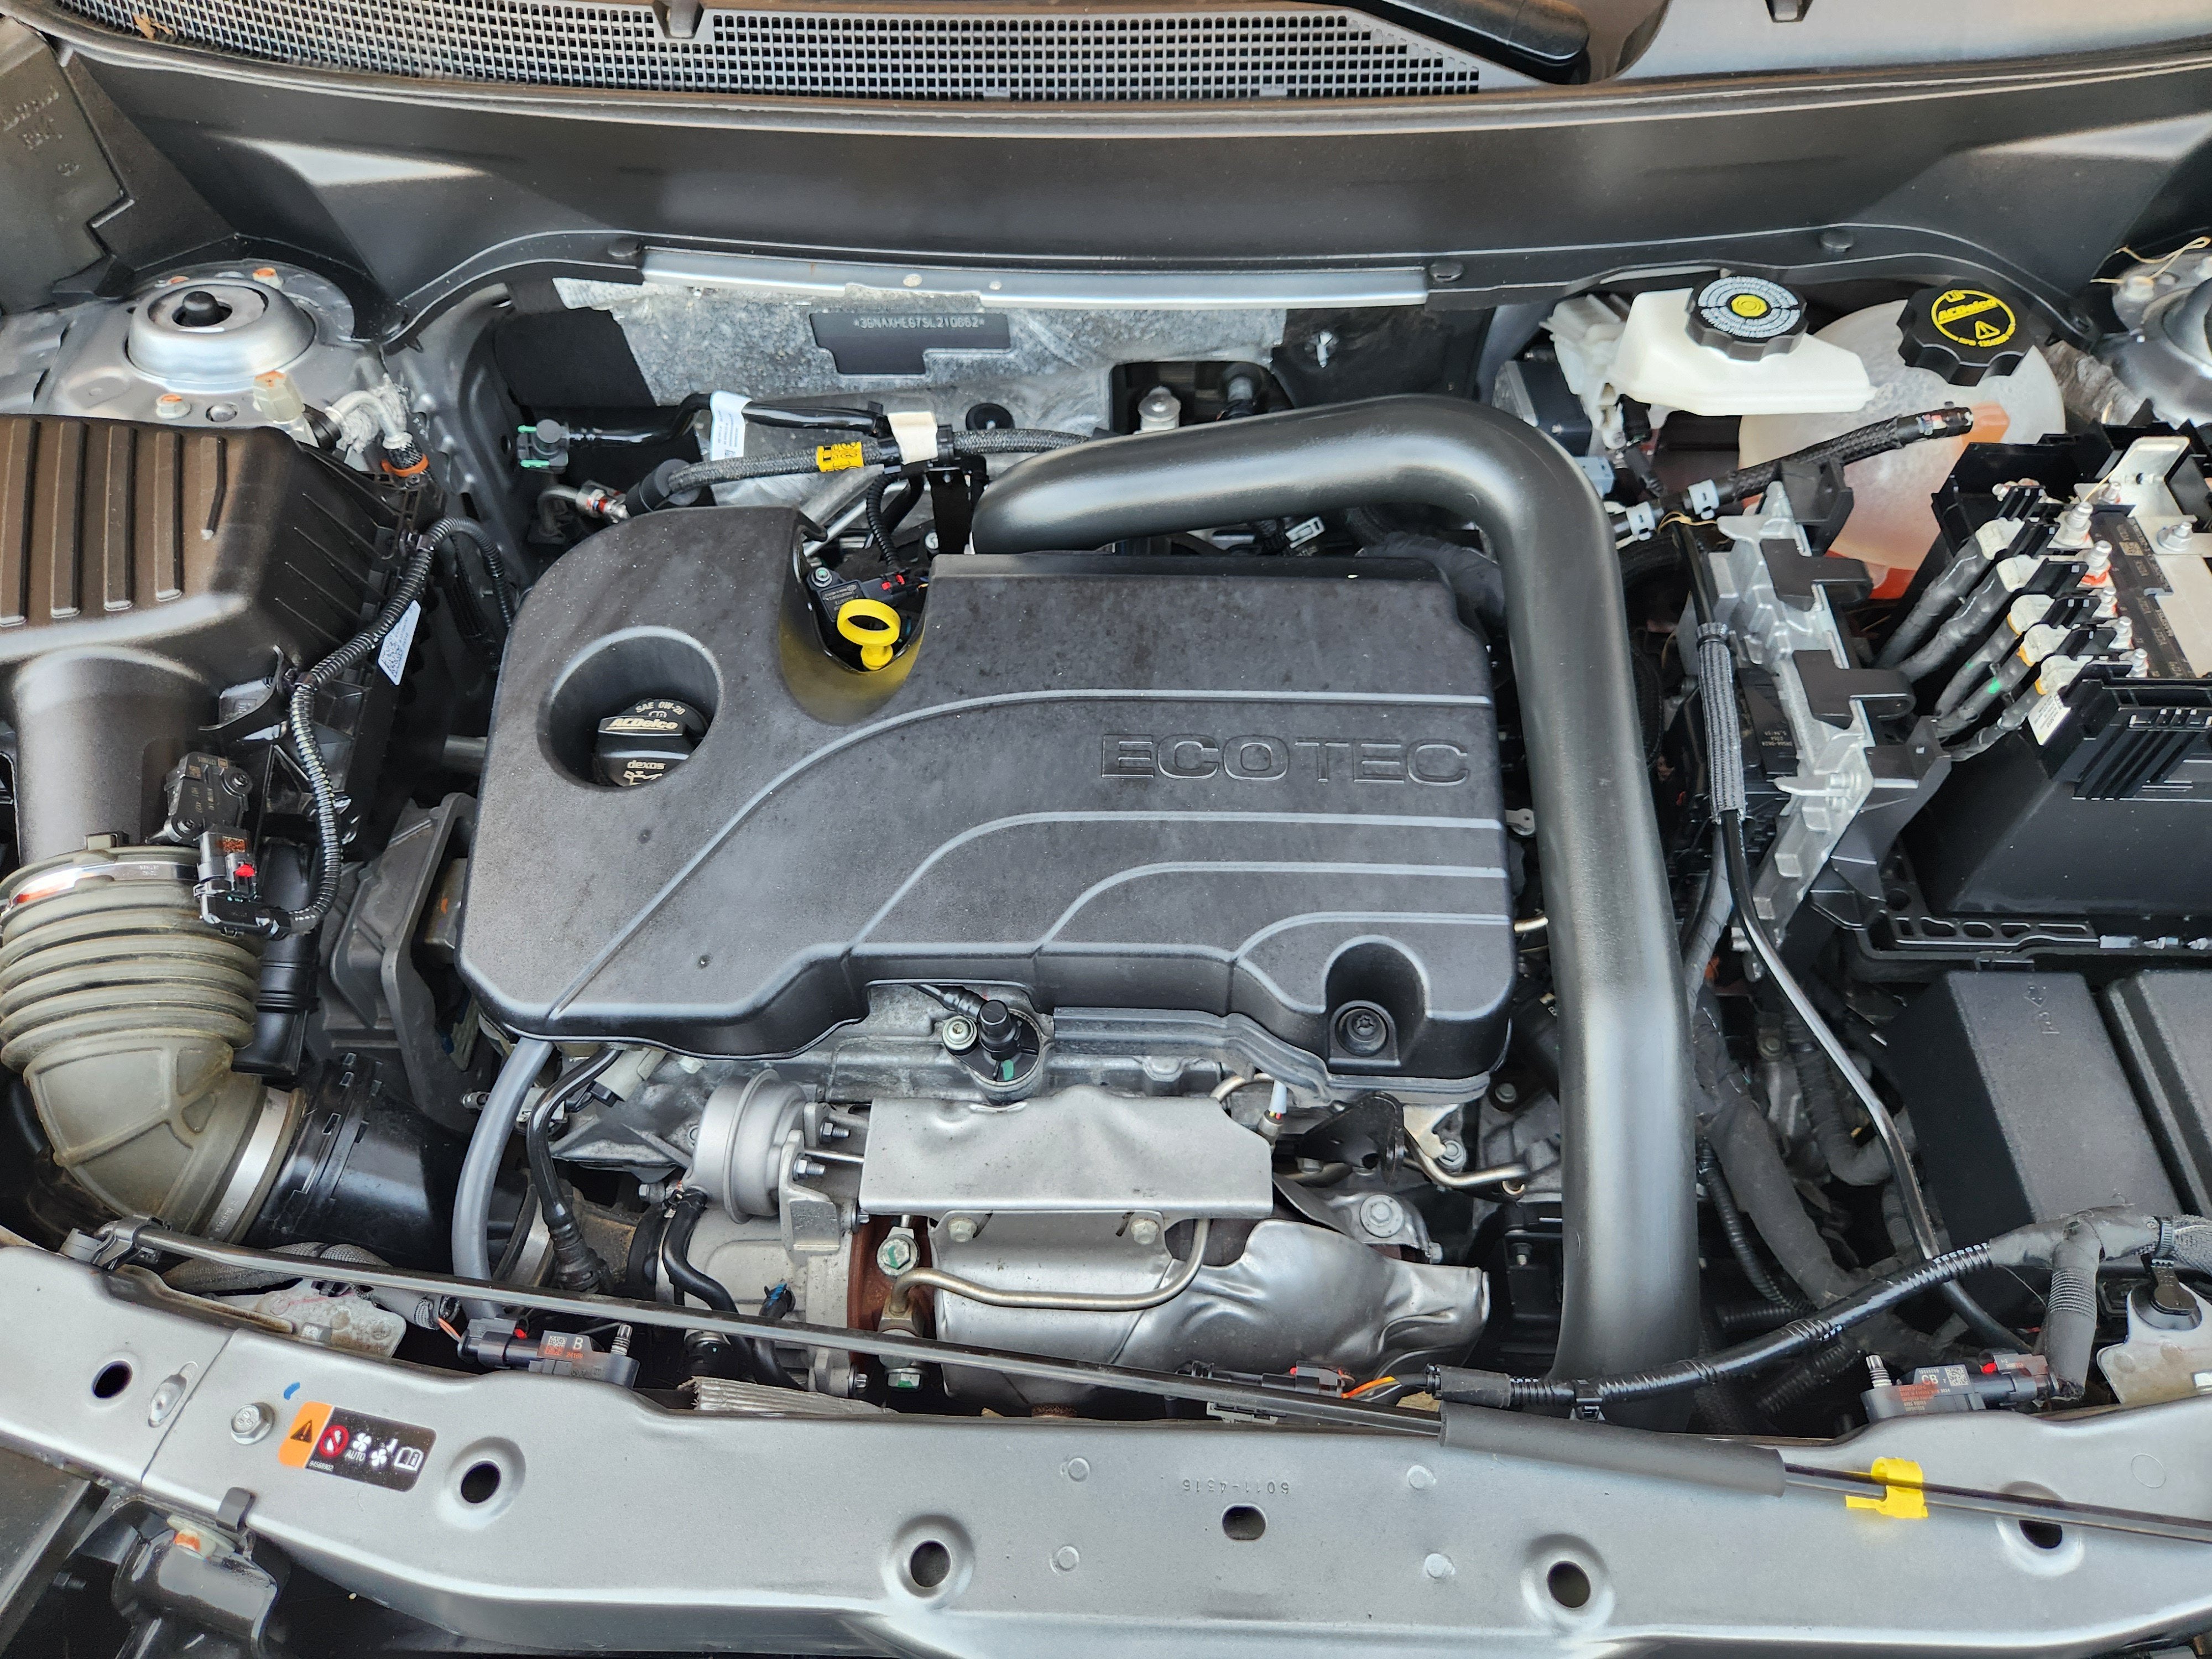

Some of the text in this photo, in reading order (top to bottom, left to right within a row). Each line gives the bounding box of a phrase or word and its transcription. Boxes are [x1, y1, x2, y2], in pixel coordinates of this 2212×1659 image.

[1938, 299, 1997, 321] ACDelco
[635, 701, 686, 715] SAE 0W-20
[609, 718, 679, 729] ACDelco
[627, 760, 666, 769] dexos
[1102, 734, 1469, 786] ECOTEC
[573, 1337, 583, 1349] B
[1922, 1374, 1938, 1385] CB
[345, 1449, 365, 1462] AUTO
